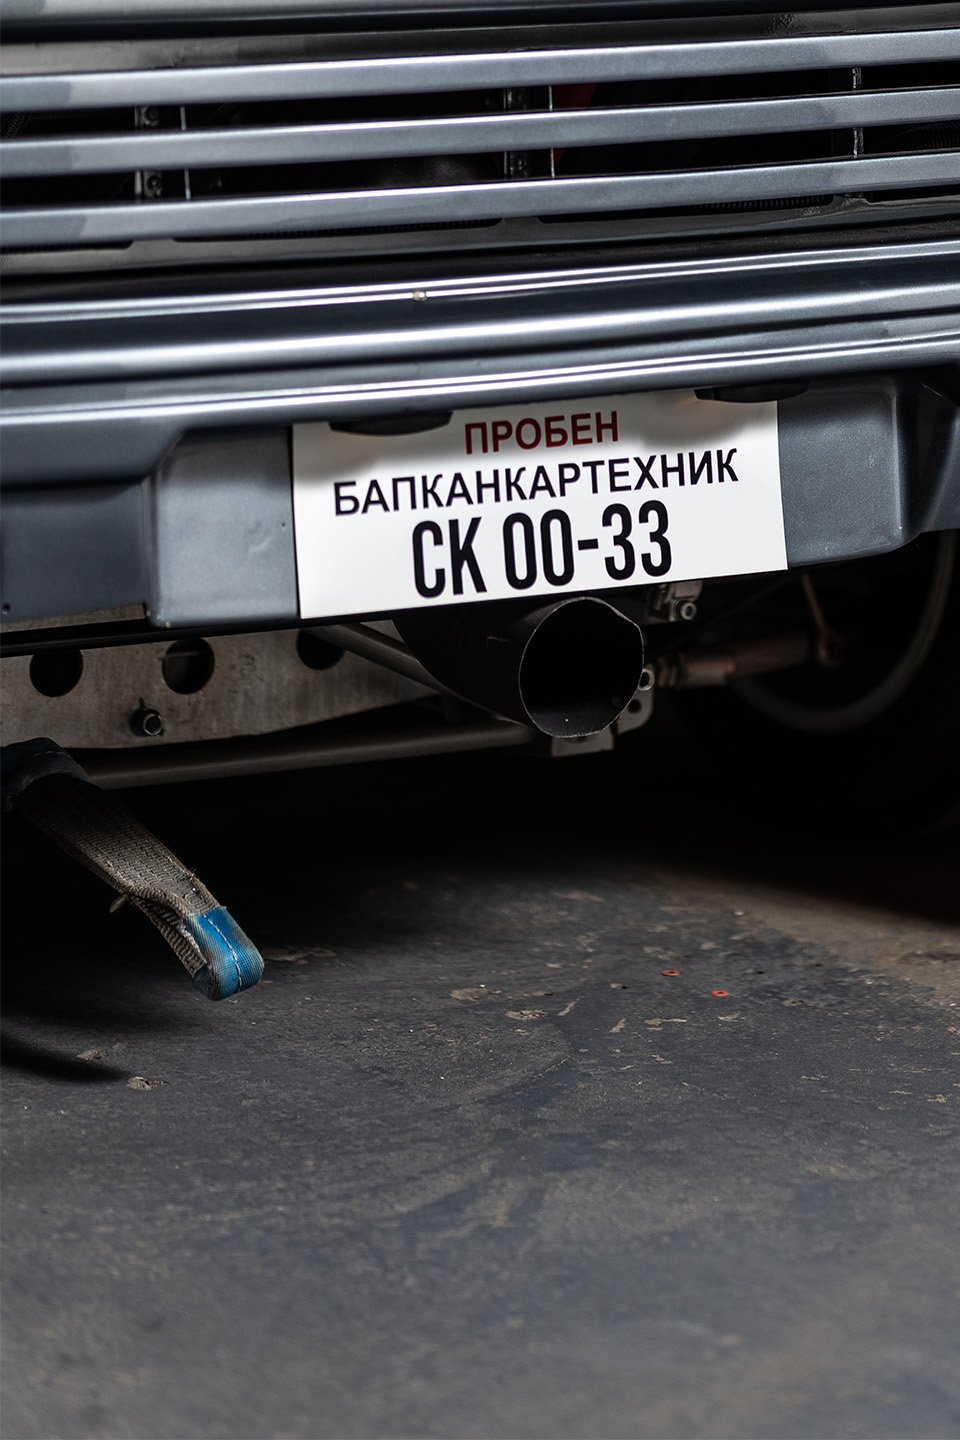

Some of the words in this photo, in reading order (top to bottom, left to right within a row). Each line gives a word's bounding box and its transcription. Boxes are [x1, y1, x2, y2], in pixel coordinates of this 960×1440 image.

[464, 410, 619, 455] ПРОБЕН
[333, 448, 739, 516] БАПКАНКАРТЕХНИК
[412, 517, 488, 598] СК
[503, 500, 672, 590] 00-33
